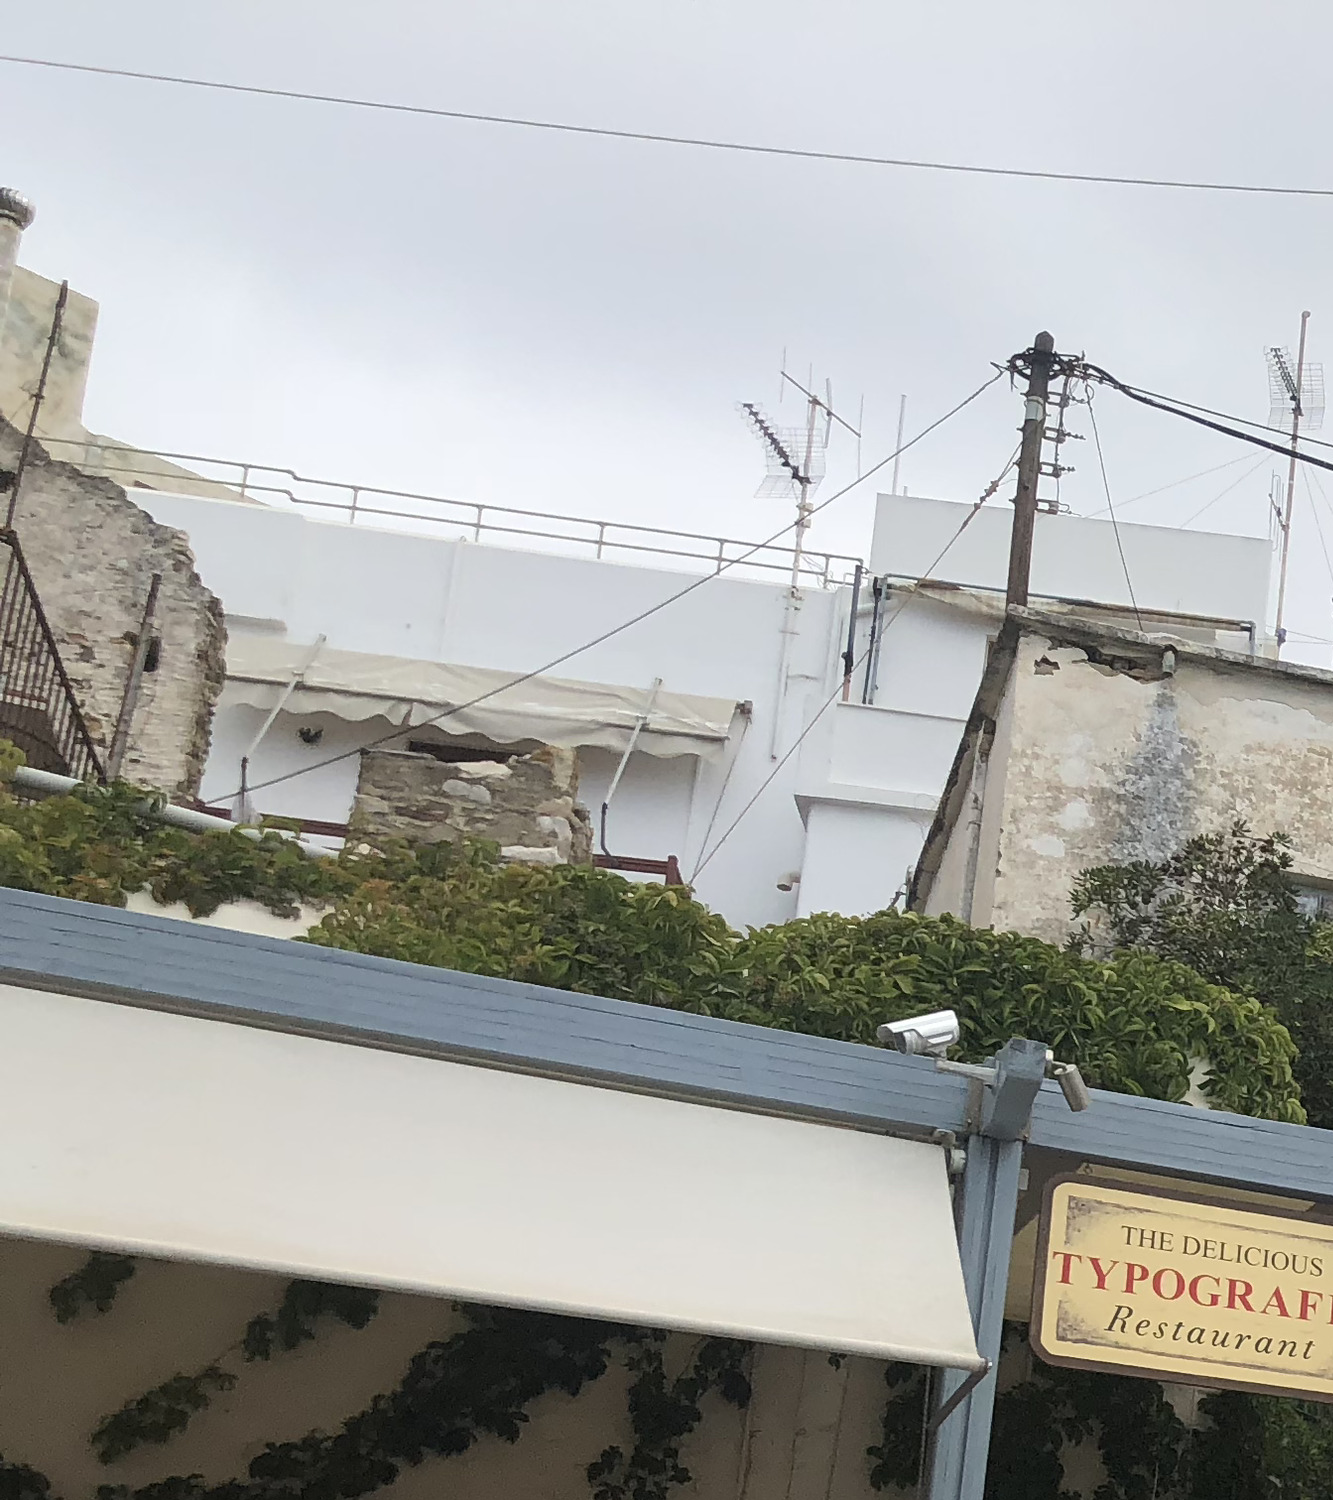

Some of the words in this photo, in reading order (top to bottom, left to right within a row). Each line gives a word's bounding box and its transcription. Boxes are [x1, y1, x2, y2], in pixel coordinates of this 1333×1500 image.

[1121, 1225, 1174, 1252] THE
[1182, 1235, 1324, 1278] DELICIOUS
[1104, 1304, 1317, 1360] Restaurant
